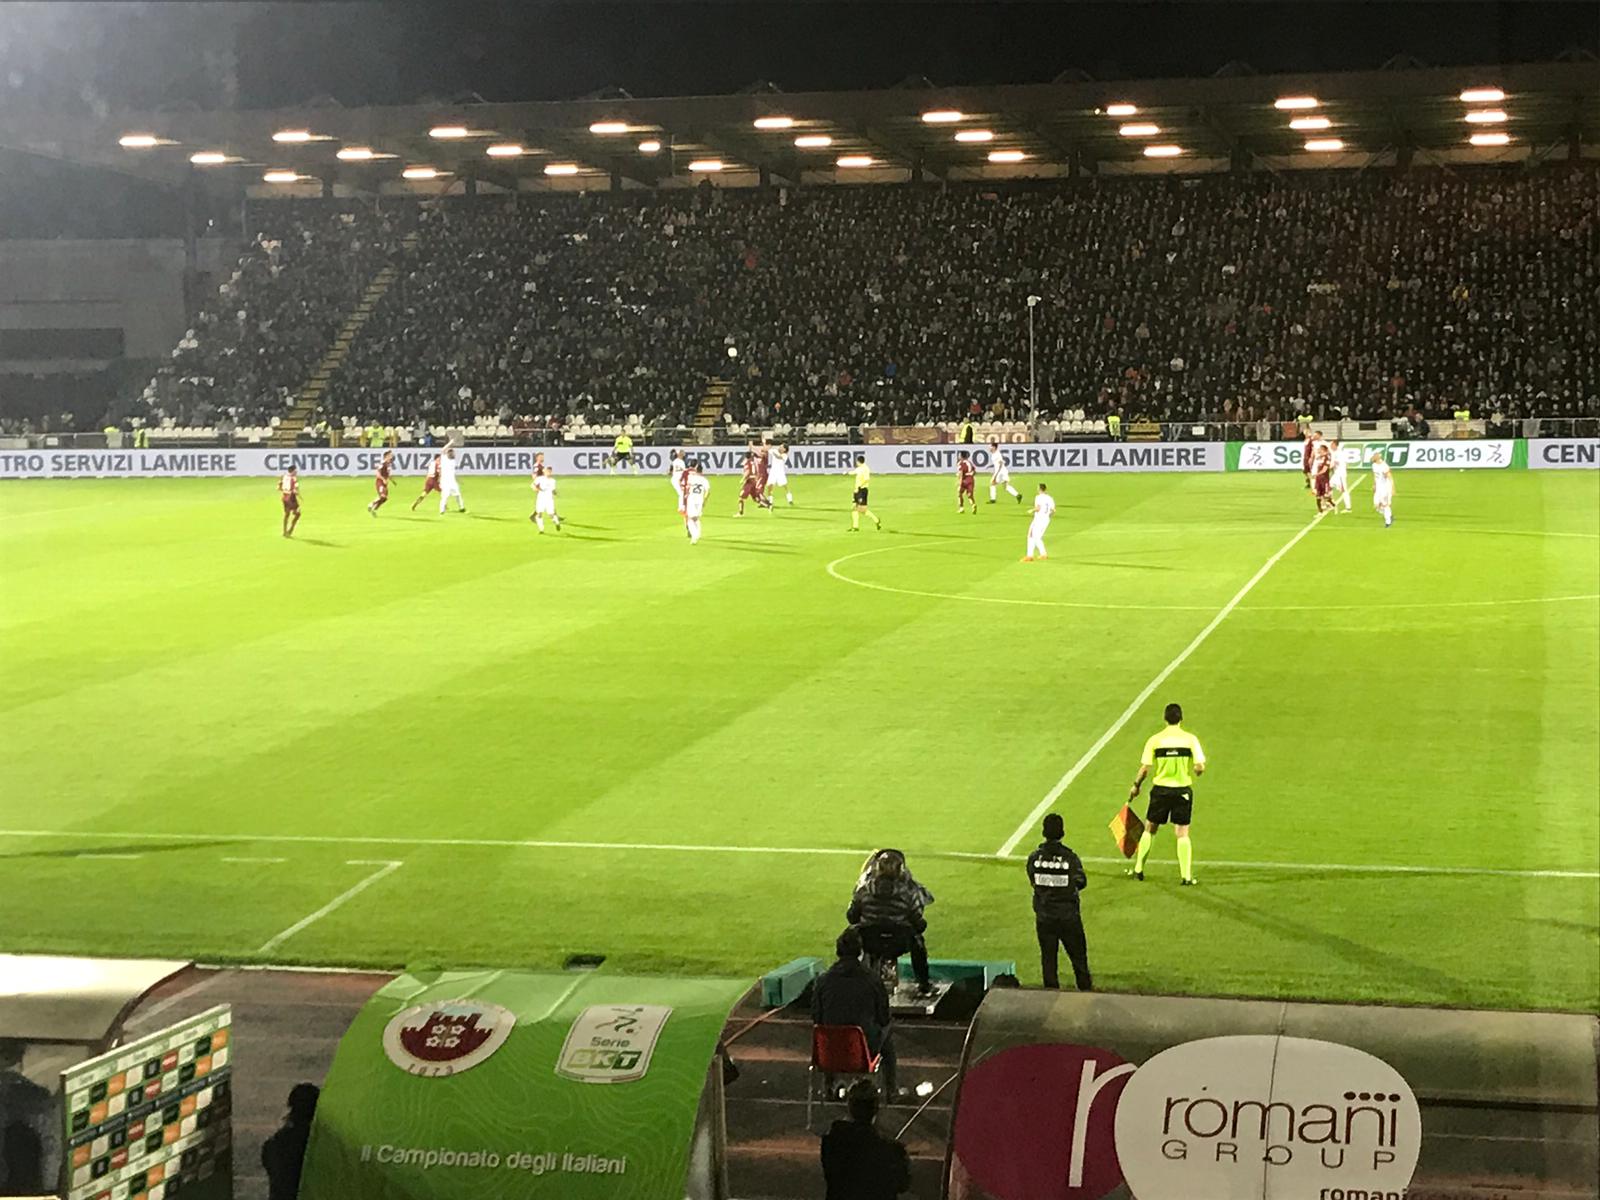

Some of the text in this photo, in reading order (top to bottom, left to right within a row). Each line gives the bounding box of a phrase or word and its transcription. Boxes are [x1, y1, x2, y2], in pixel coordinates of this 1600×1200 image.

[51, 454, 133, 471] SERVIZI
[141, 454, 236, 471] LAMIERE
[264, 452, 537, 471] CENTRO SEVIZ AMIER
[684, 451, 747, 469] ERVIZ
[1097, 447, 1206, 466] LAMIERE
[1416, 447, 1482, 462] 2018-19
[1542, 444, 1600, 463] CEN
[591, 1036, 631, 1047] Serie
[567, 1049, 642, 1070] BKT
[1163, 1092, 1400, 1147] romani
[377, 1144, 500, 1169] Campionato
[506, 1152, 557, 1175] degli
[562, 1152, 627, 1174] Italiani
[1162, 1139, 1396, 1170] GROUP
